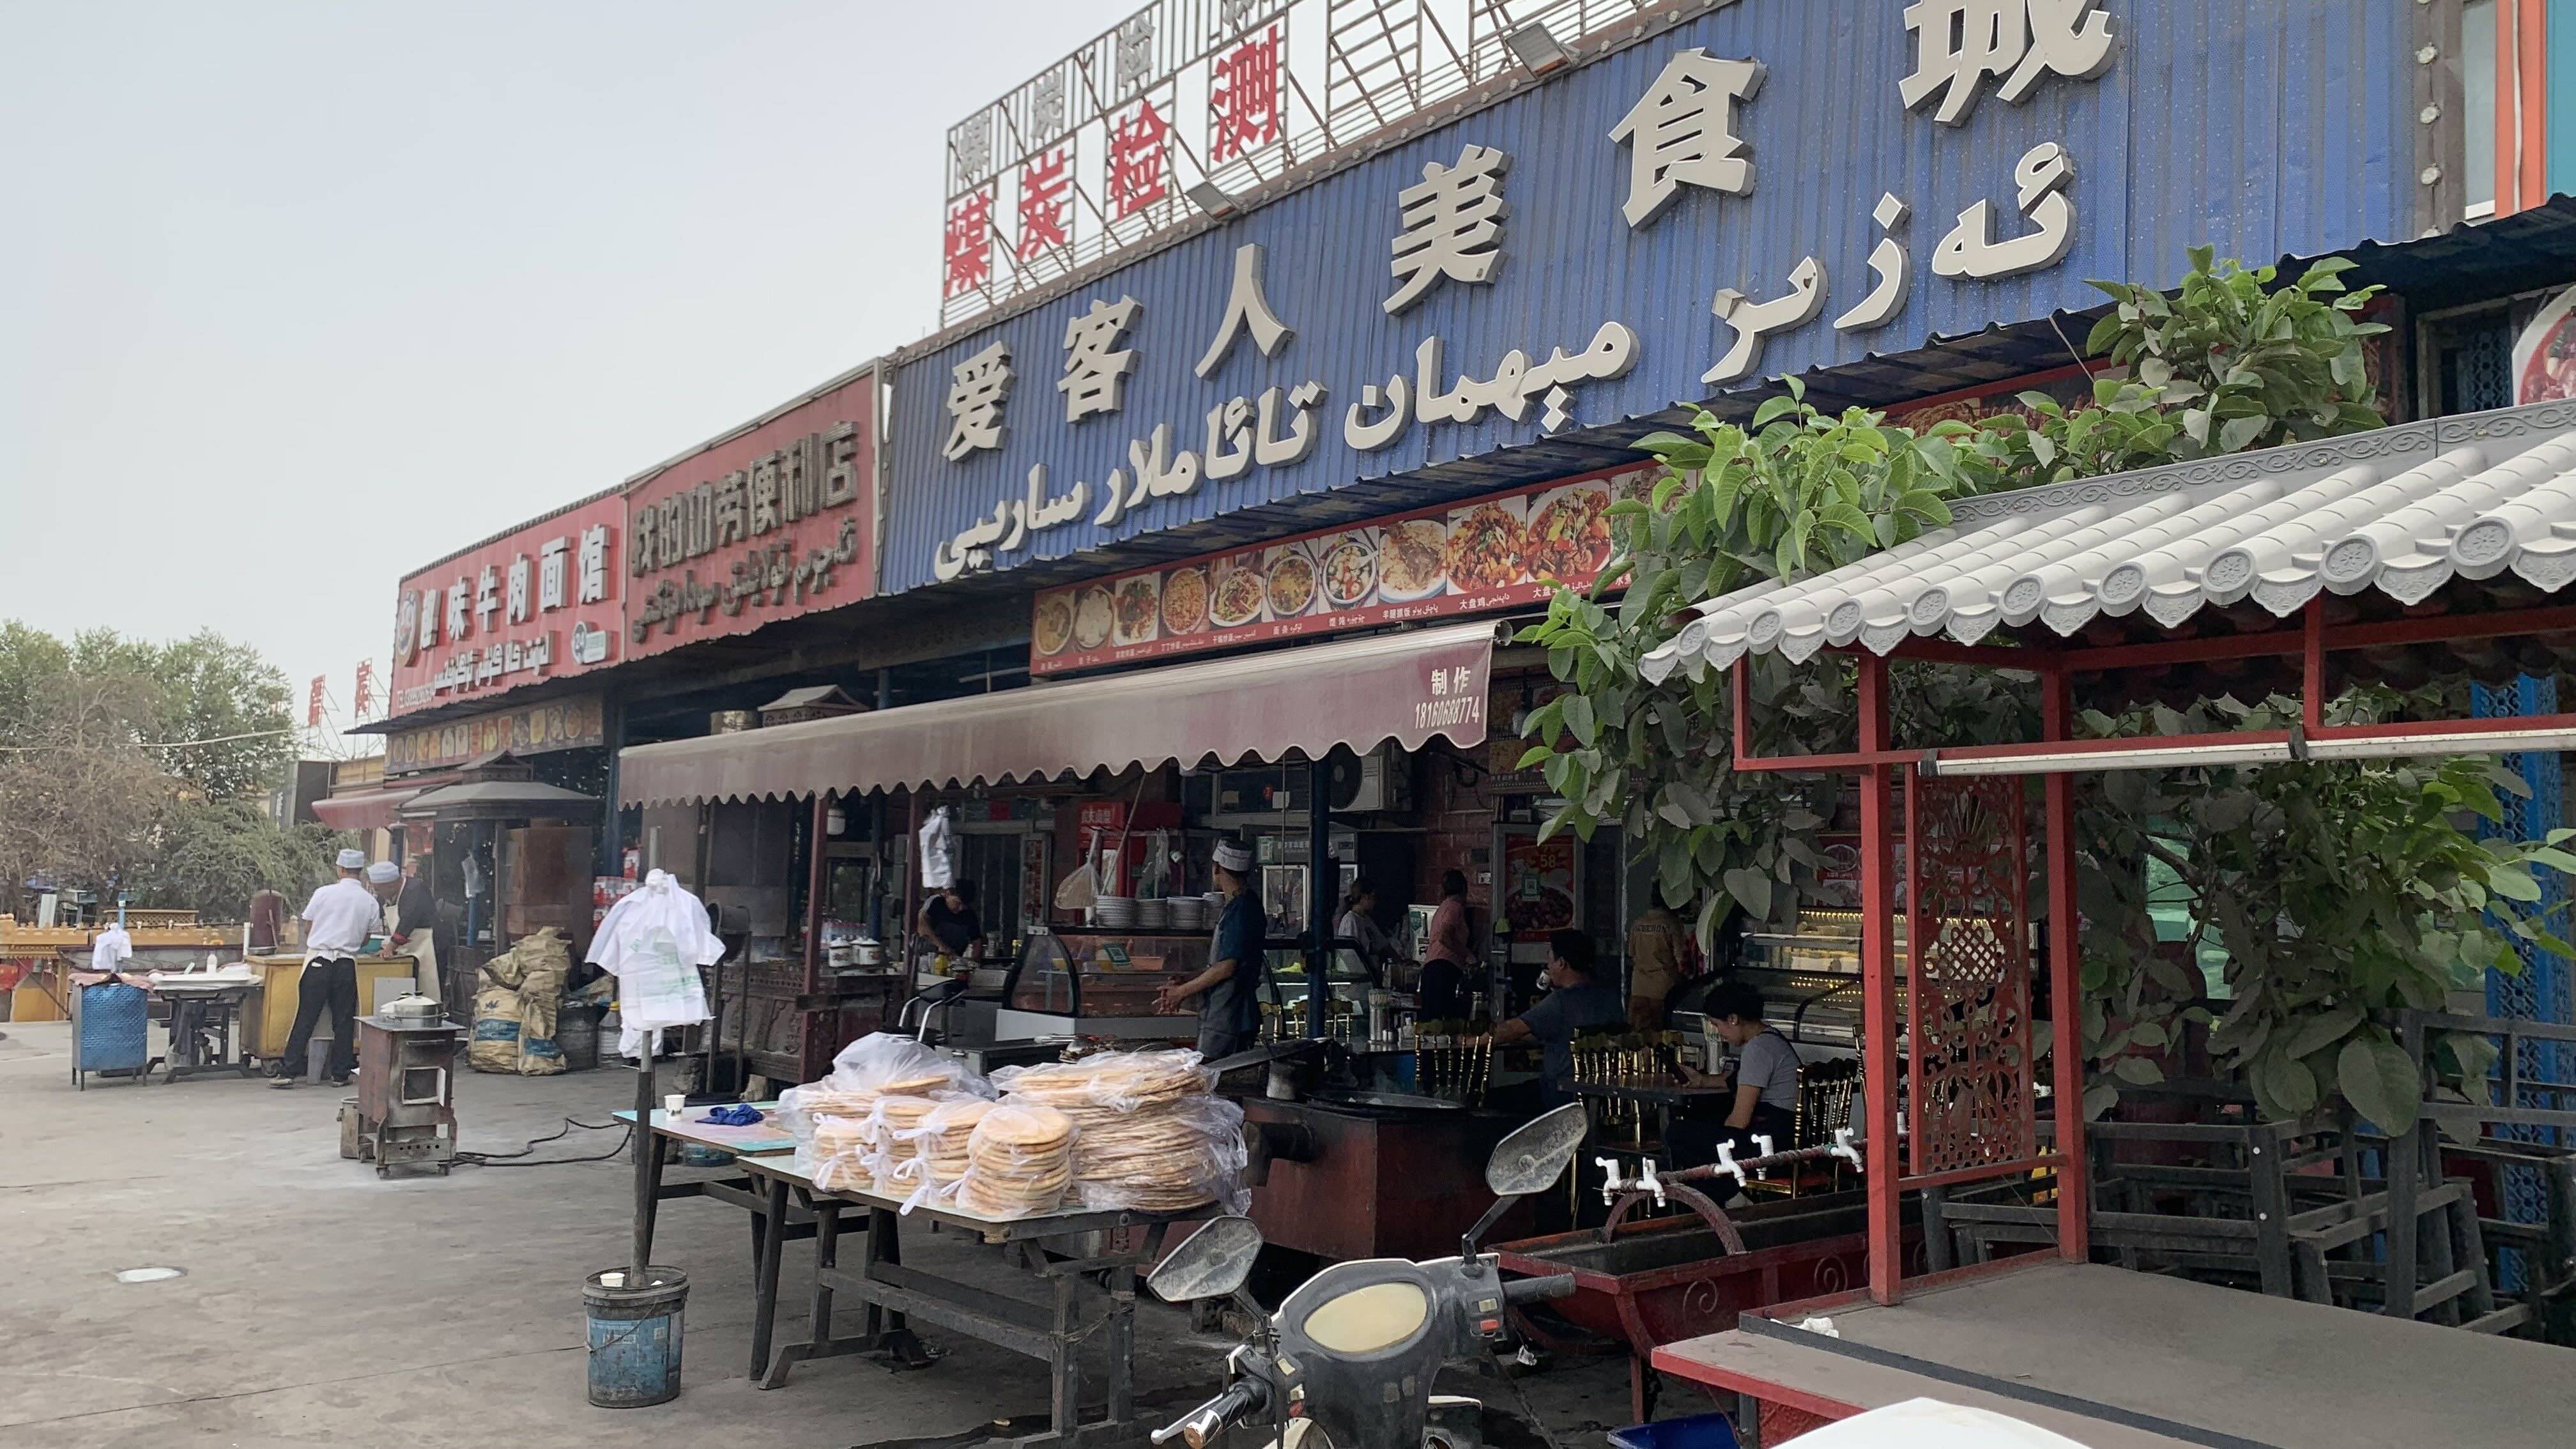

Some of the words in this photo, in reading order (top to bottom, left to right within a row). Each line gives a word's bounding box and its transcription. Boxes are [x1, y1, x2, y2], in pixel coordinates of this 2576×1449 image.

[943, 23, 1277, 298] 煤炭检测
[1459, 597, 1485, 610] 大盘鸡
[1430, 666, 1471, 696] 制作
[1414, 696, 1480, 730] 18160688774
